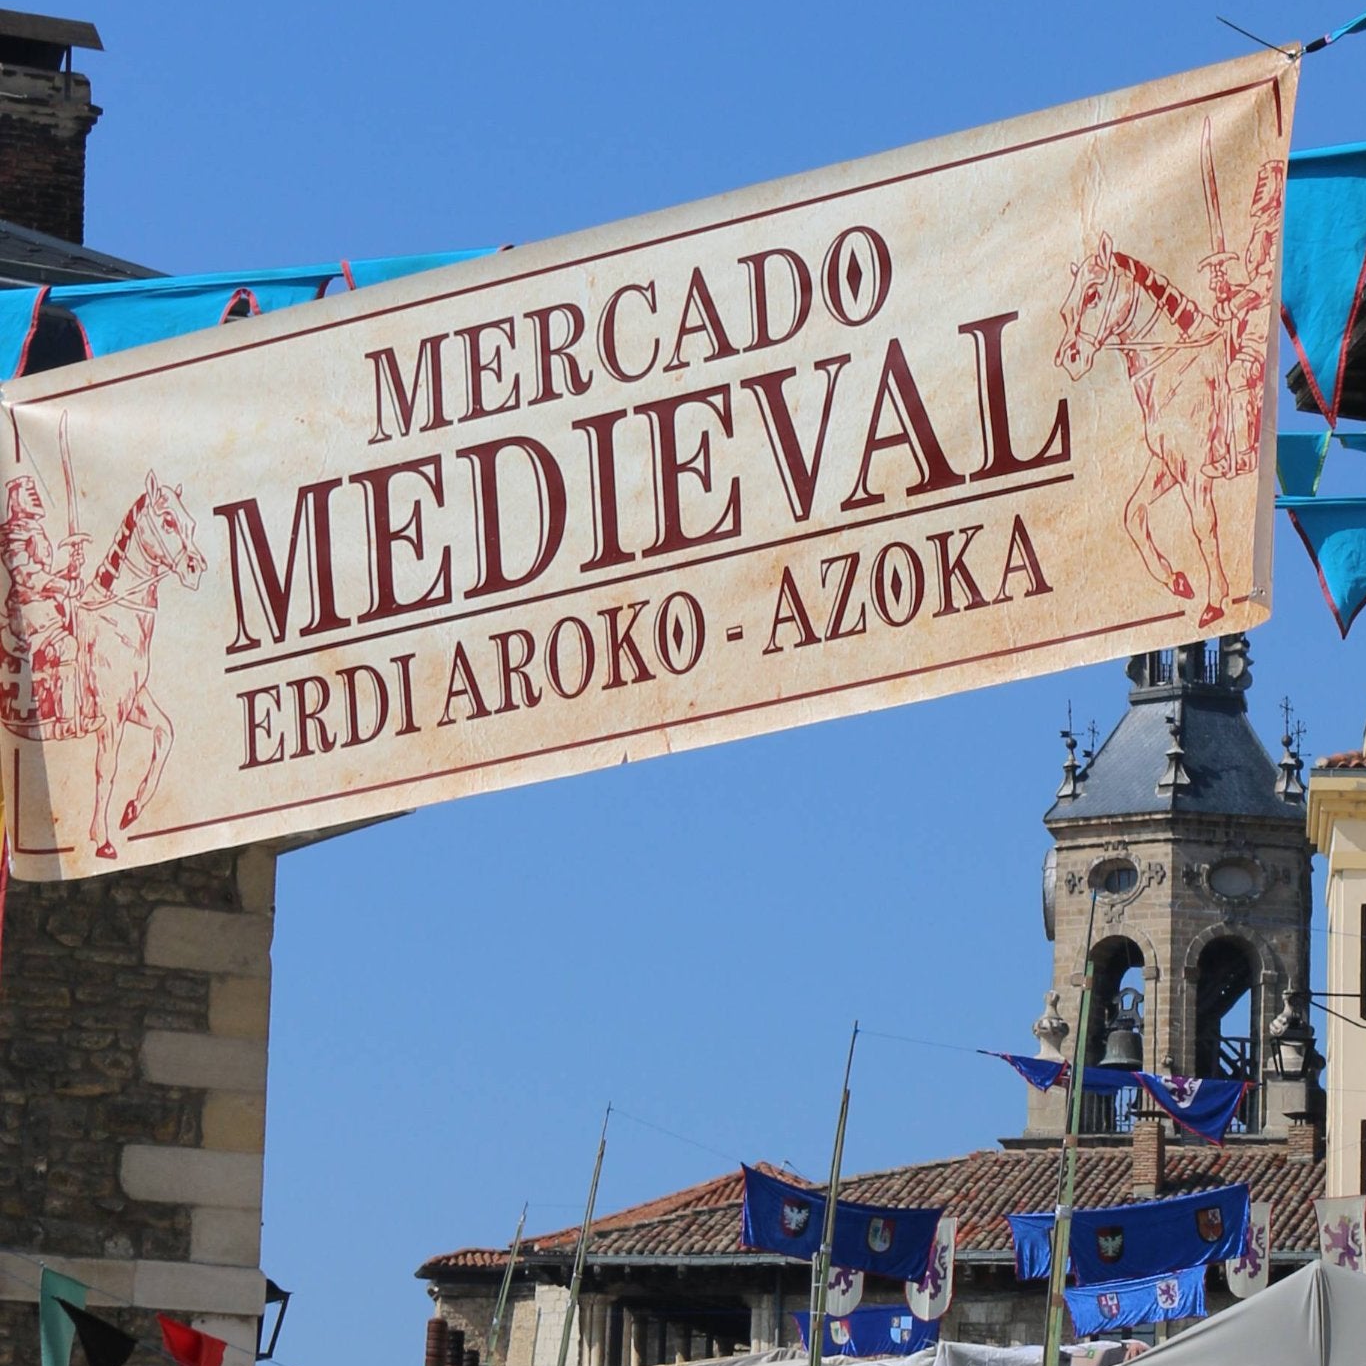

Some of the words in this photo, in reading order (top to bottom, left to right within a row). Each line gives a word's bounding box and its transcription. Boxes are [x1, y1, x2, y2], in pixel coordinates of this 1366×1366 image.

[363, 225, 893, 445] MERCADO
[212, 311, 1073, 656] MEDIEVAL
[762, 513, 1054, 656] AZOKA
